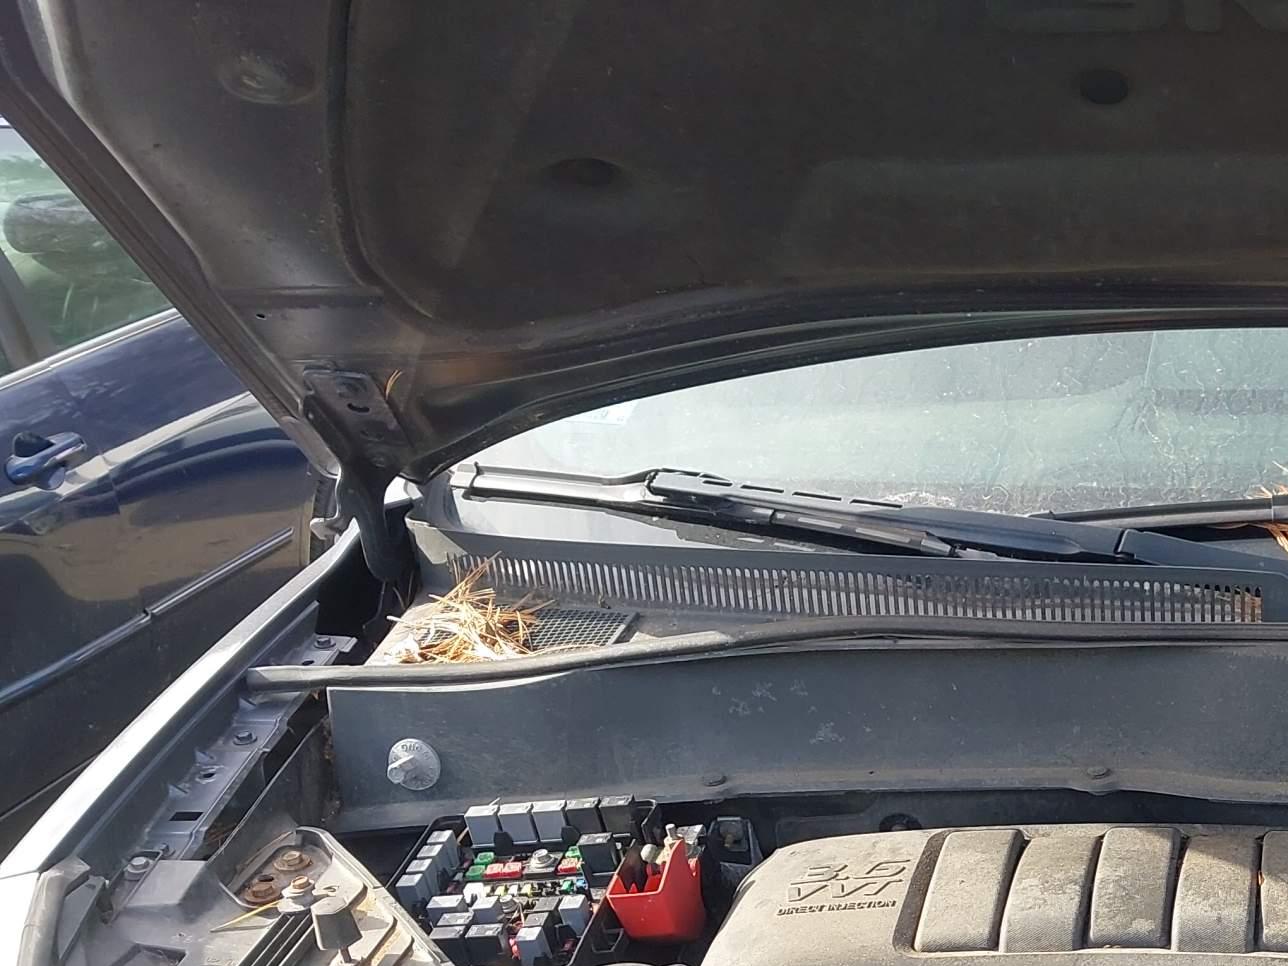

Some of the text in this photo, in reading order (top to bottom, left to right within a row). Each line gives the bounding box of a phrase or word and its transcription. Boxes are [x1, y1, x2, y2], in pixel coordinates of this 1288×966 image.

[790, 859, 911, 885] 3.6
[787, 879, 904, 903] VVT
[776, 900, 898, 917] DIRECT INJECTION
